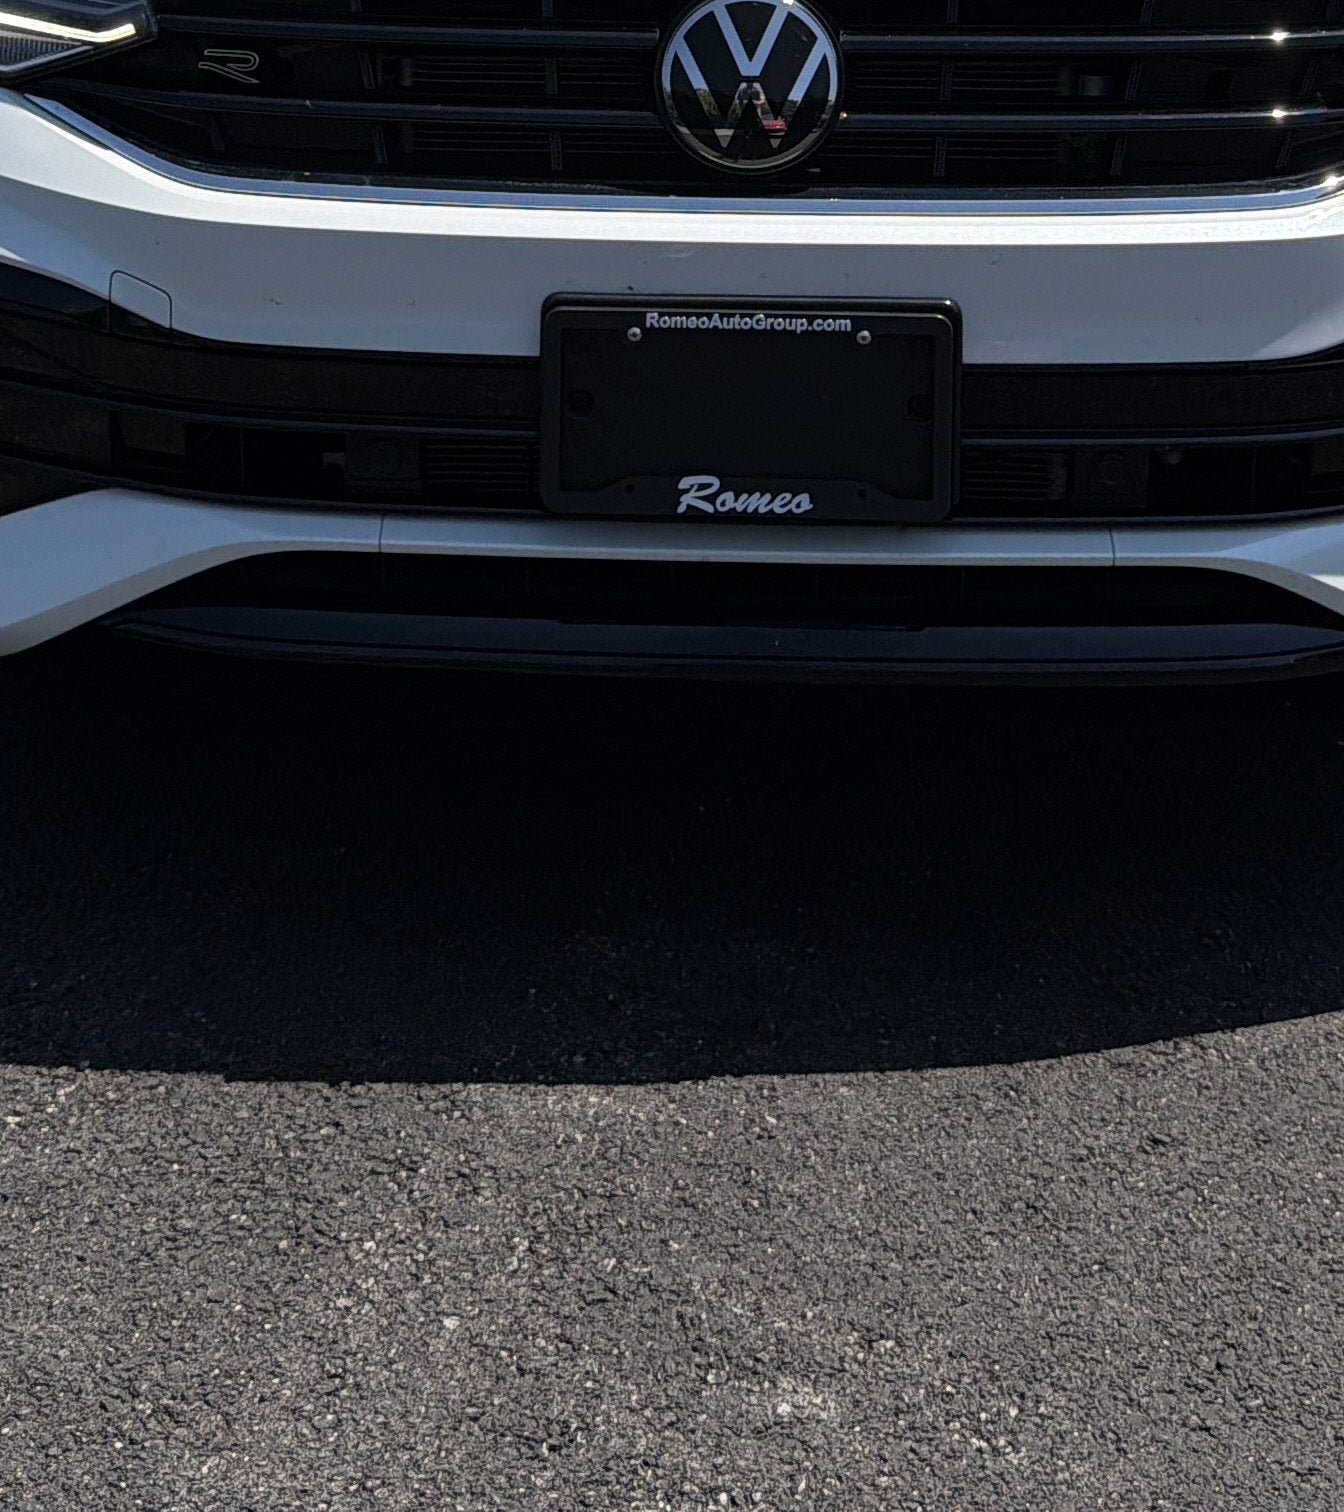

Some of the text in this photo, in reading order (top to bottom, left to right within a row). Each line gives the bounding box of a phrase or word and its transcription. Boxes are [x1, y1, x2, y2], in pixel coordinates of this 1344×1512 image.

[197, 48, 260, 83] R
[645, 312, 852, 334] RomeoAutoGroup.com
[676, 475, 814, 514] Romeo
